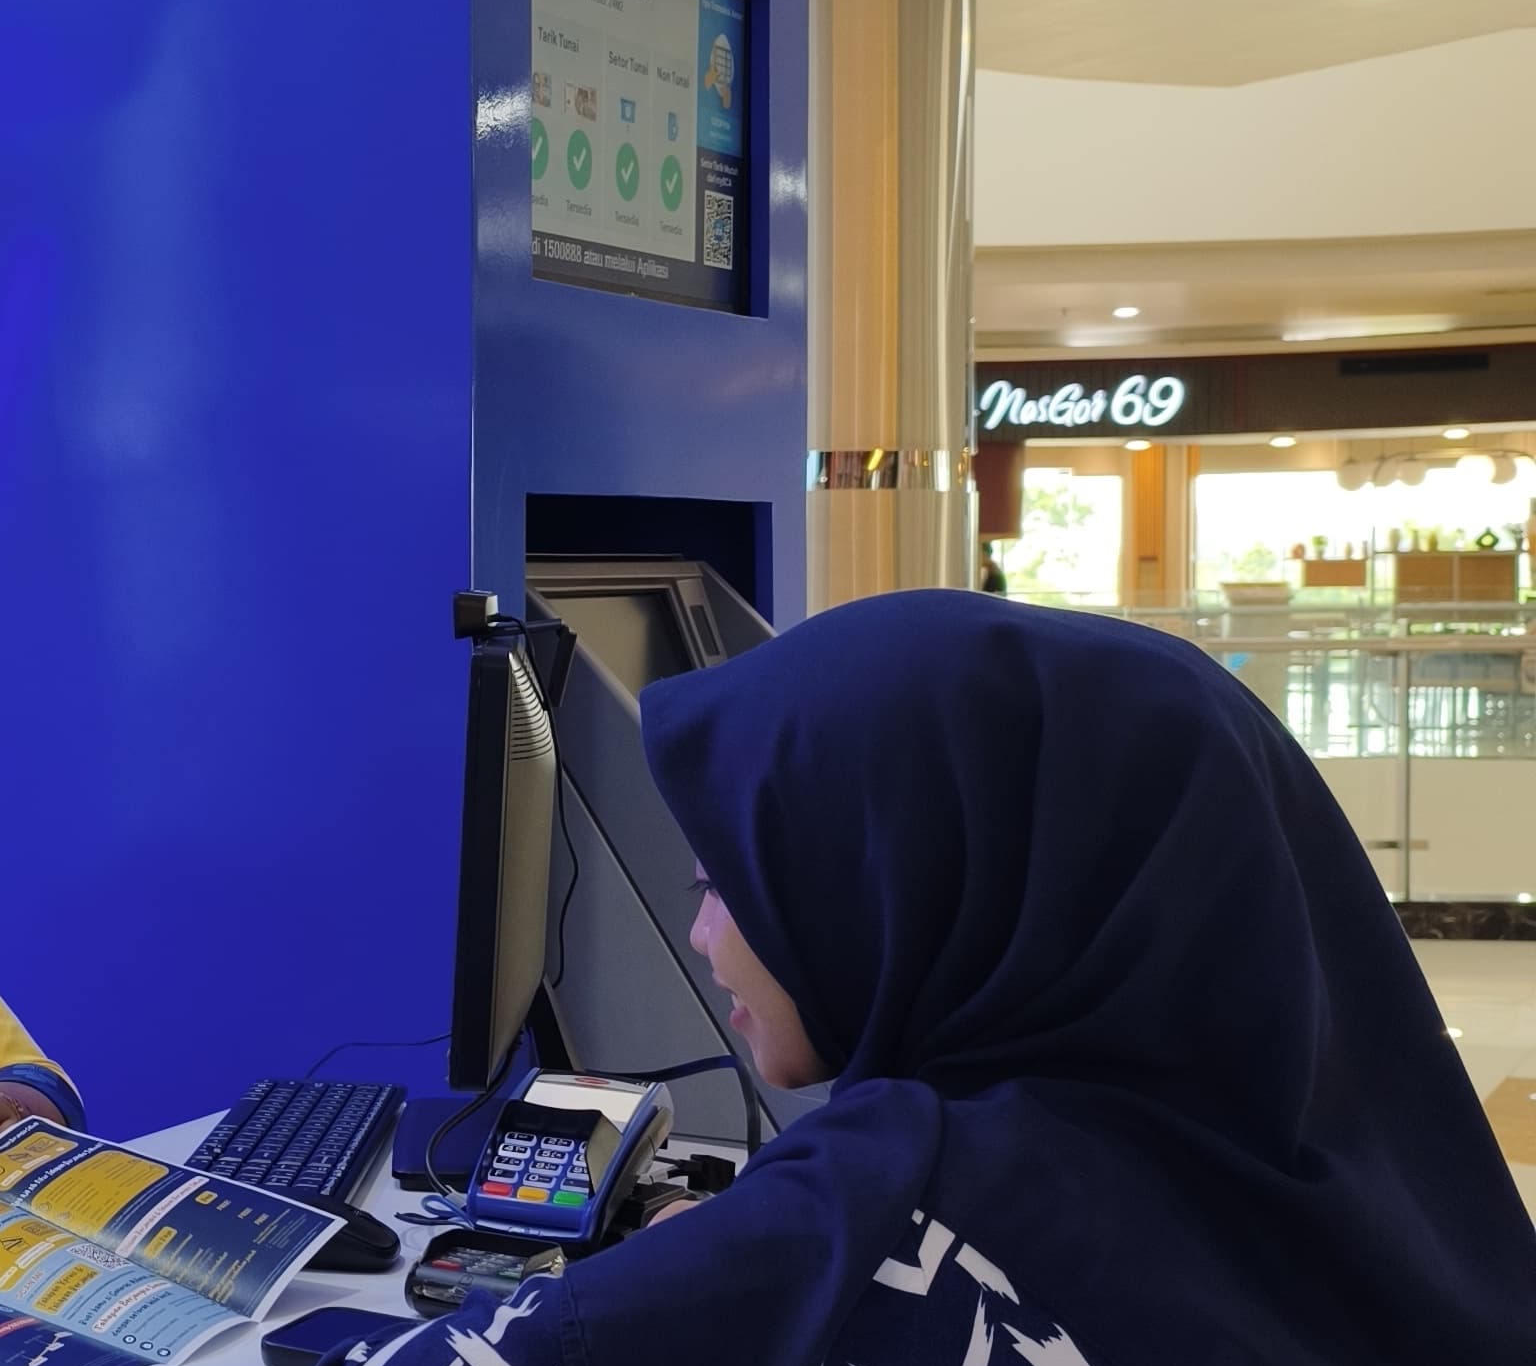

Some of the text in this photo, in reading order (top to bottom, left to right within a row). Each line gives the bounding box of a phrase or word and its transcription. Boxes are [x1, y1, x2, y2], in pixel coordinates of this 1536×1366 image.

[537, 26, 579, 53] Tarik Tunai
[608, 50, 649, 76] Setor Tunai
[656, 66, 690, 89] Non Tunai
[543, 238, 582, 263] 1500888
[583, 249, 603, 267] atau
[604, 253, 636, 273] melalui
[636, 257, 669, 280] Aplikasi
[1111, 374, 1184, 426] 69
